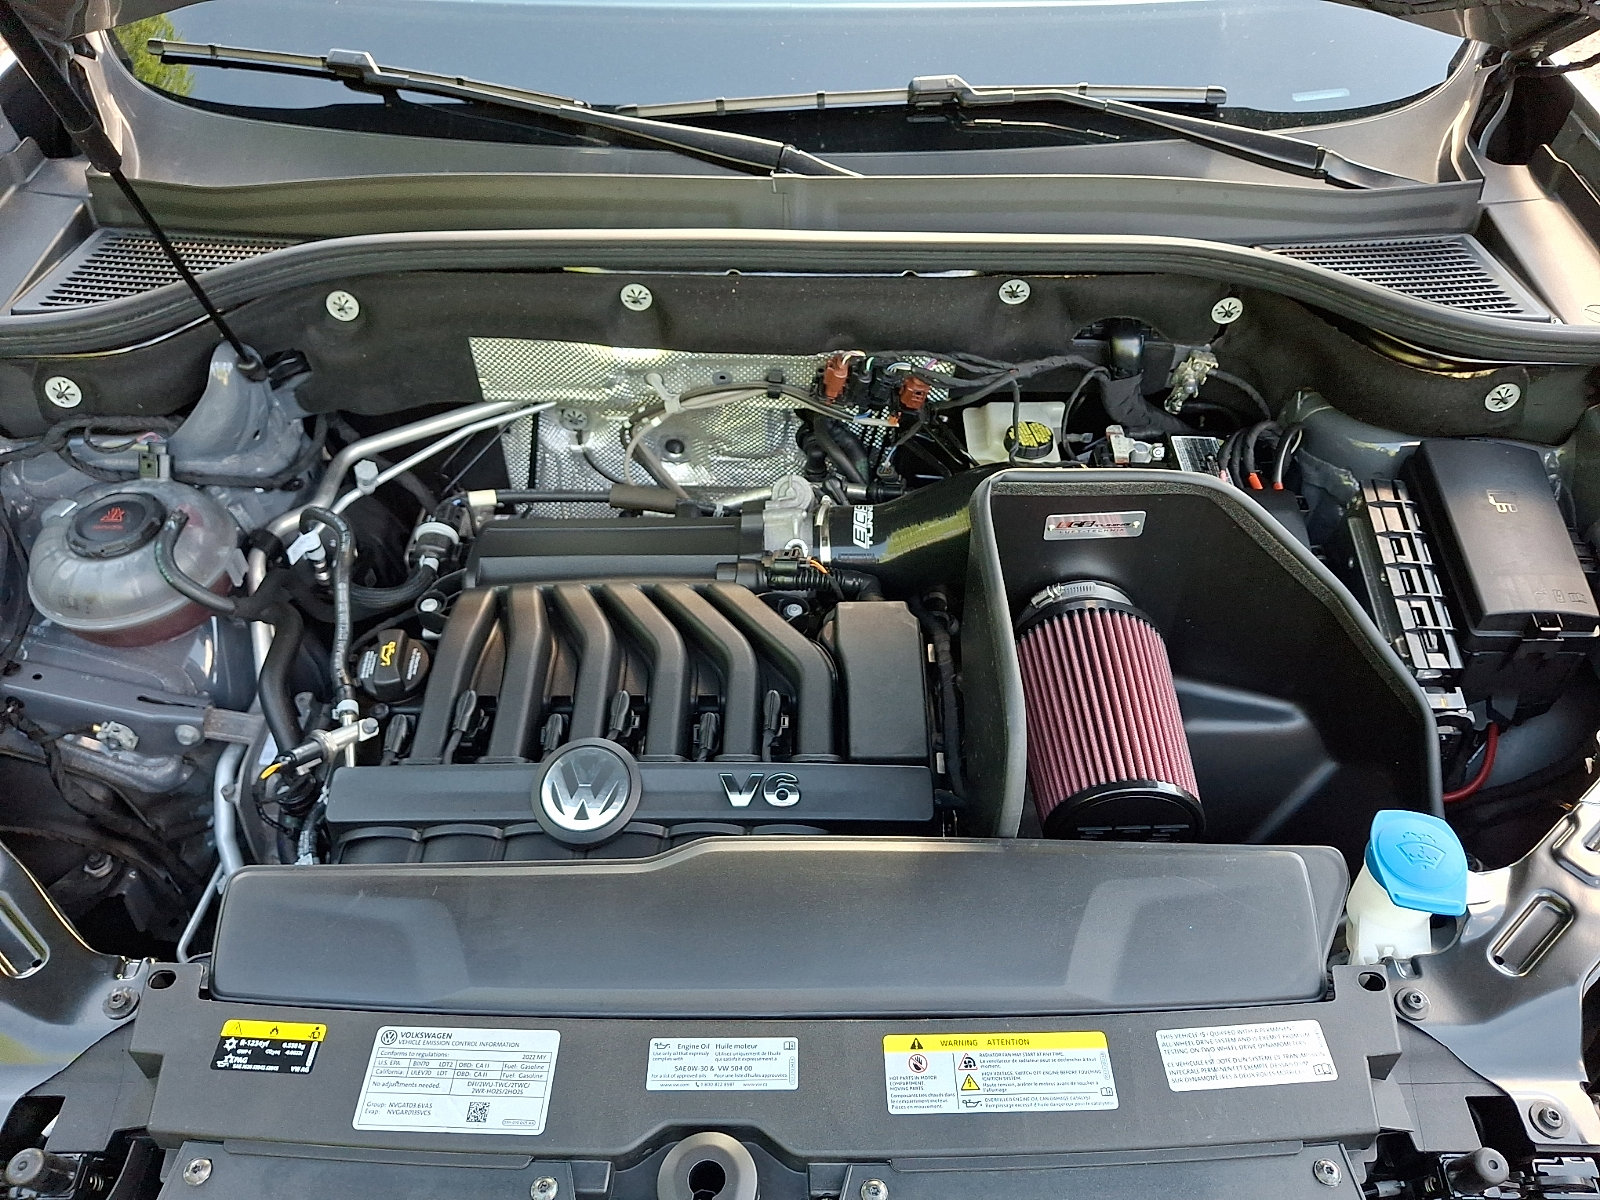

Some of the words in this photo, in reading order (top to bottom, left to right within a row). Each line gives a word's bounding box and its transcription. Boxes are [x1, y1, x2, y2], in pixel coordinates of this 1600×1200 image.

[720, 772, 800, 807] V6
[400, 1032, 452, 1040] VOLKSWAGEN
[987, 1038, 1030, 1046] ATTENTION
